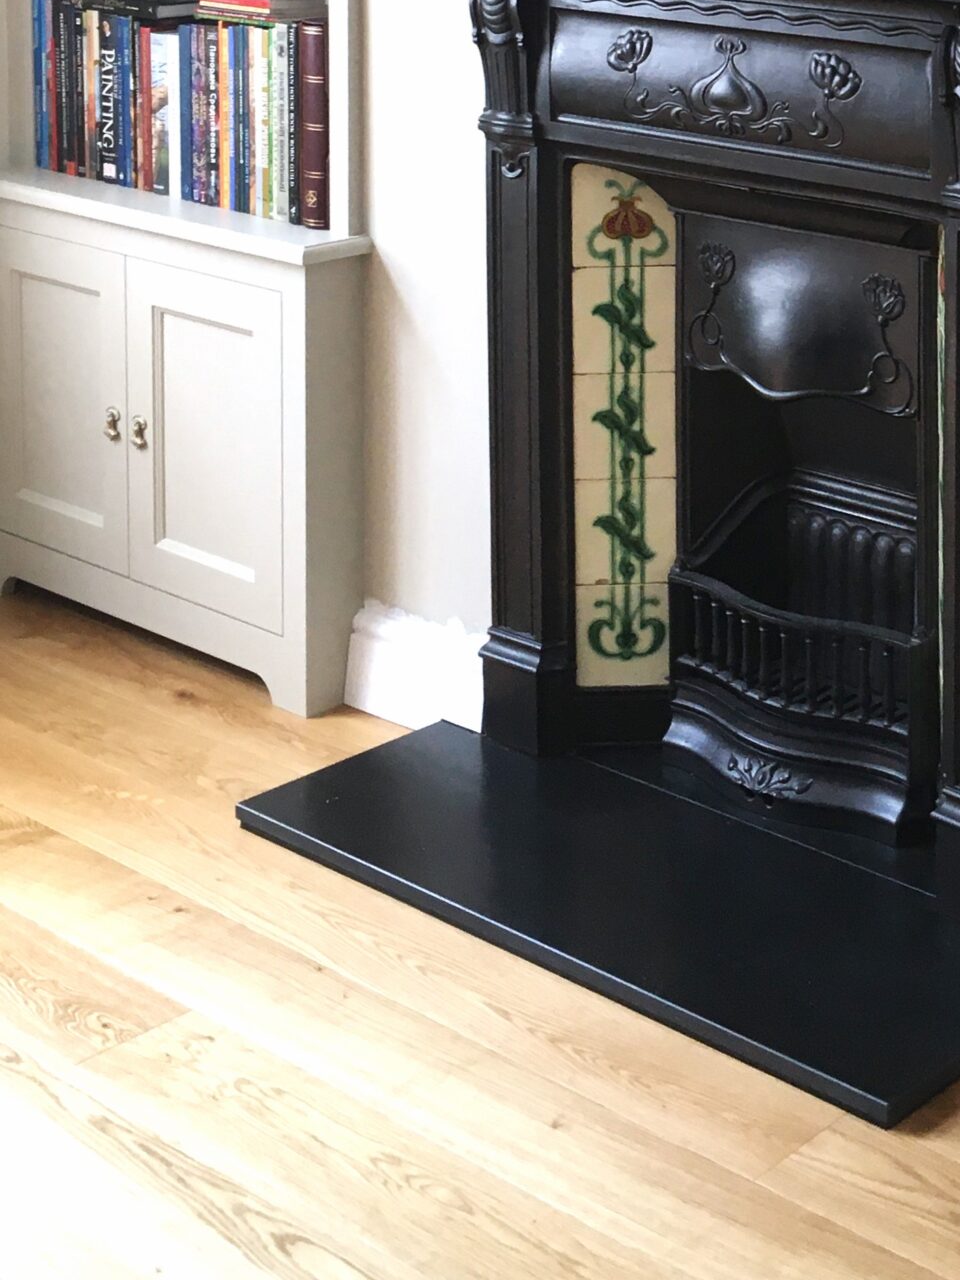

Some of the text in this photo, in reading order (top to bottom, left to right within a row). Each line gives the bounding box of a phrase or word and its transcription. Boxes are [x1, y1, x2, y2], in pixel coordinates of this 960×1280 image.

[101, 49, 116, 148] PAINTING
[208, 45, 217, 164] Панорама Средневековья
